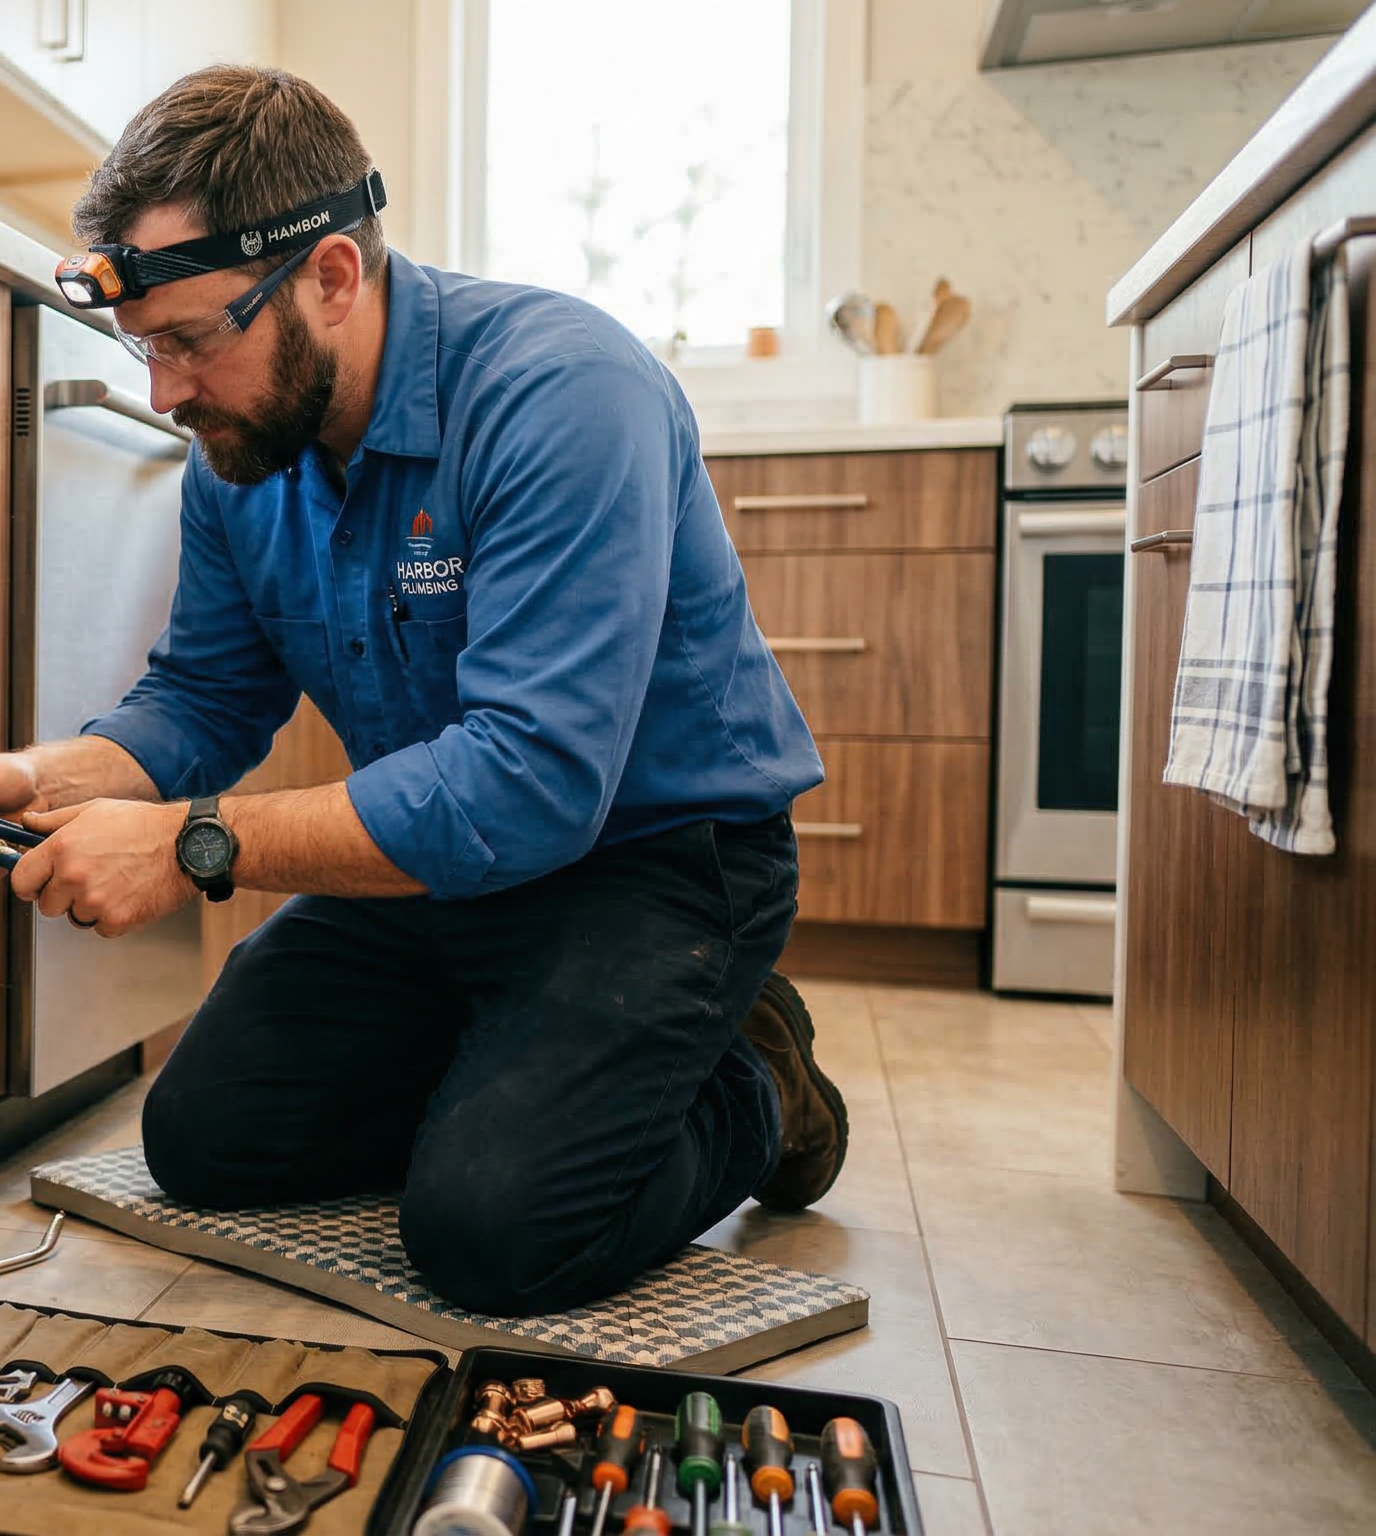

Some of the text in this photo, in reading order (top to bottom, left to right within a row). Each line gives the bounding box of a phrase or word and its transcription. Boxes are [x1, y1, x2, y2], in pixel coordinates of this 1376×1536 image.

[267, 211, 331, 243] HAMBON
[397, 557, 464, 580] HARBOR
[401, 579, 459, 595] PLUMBING
